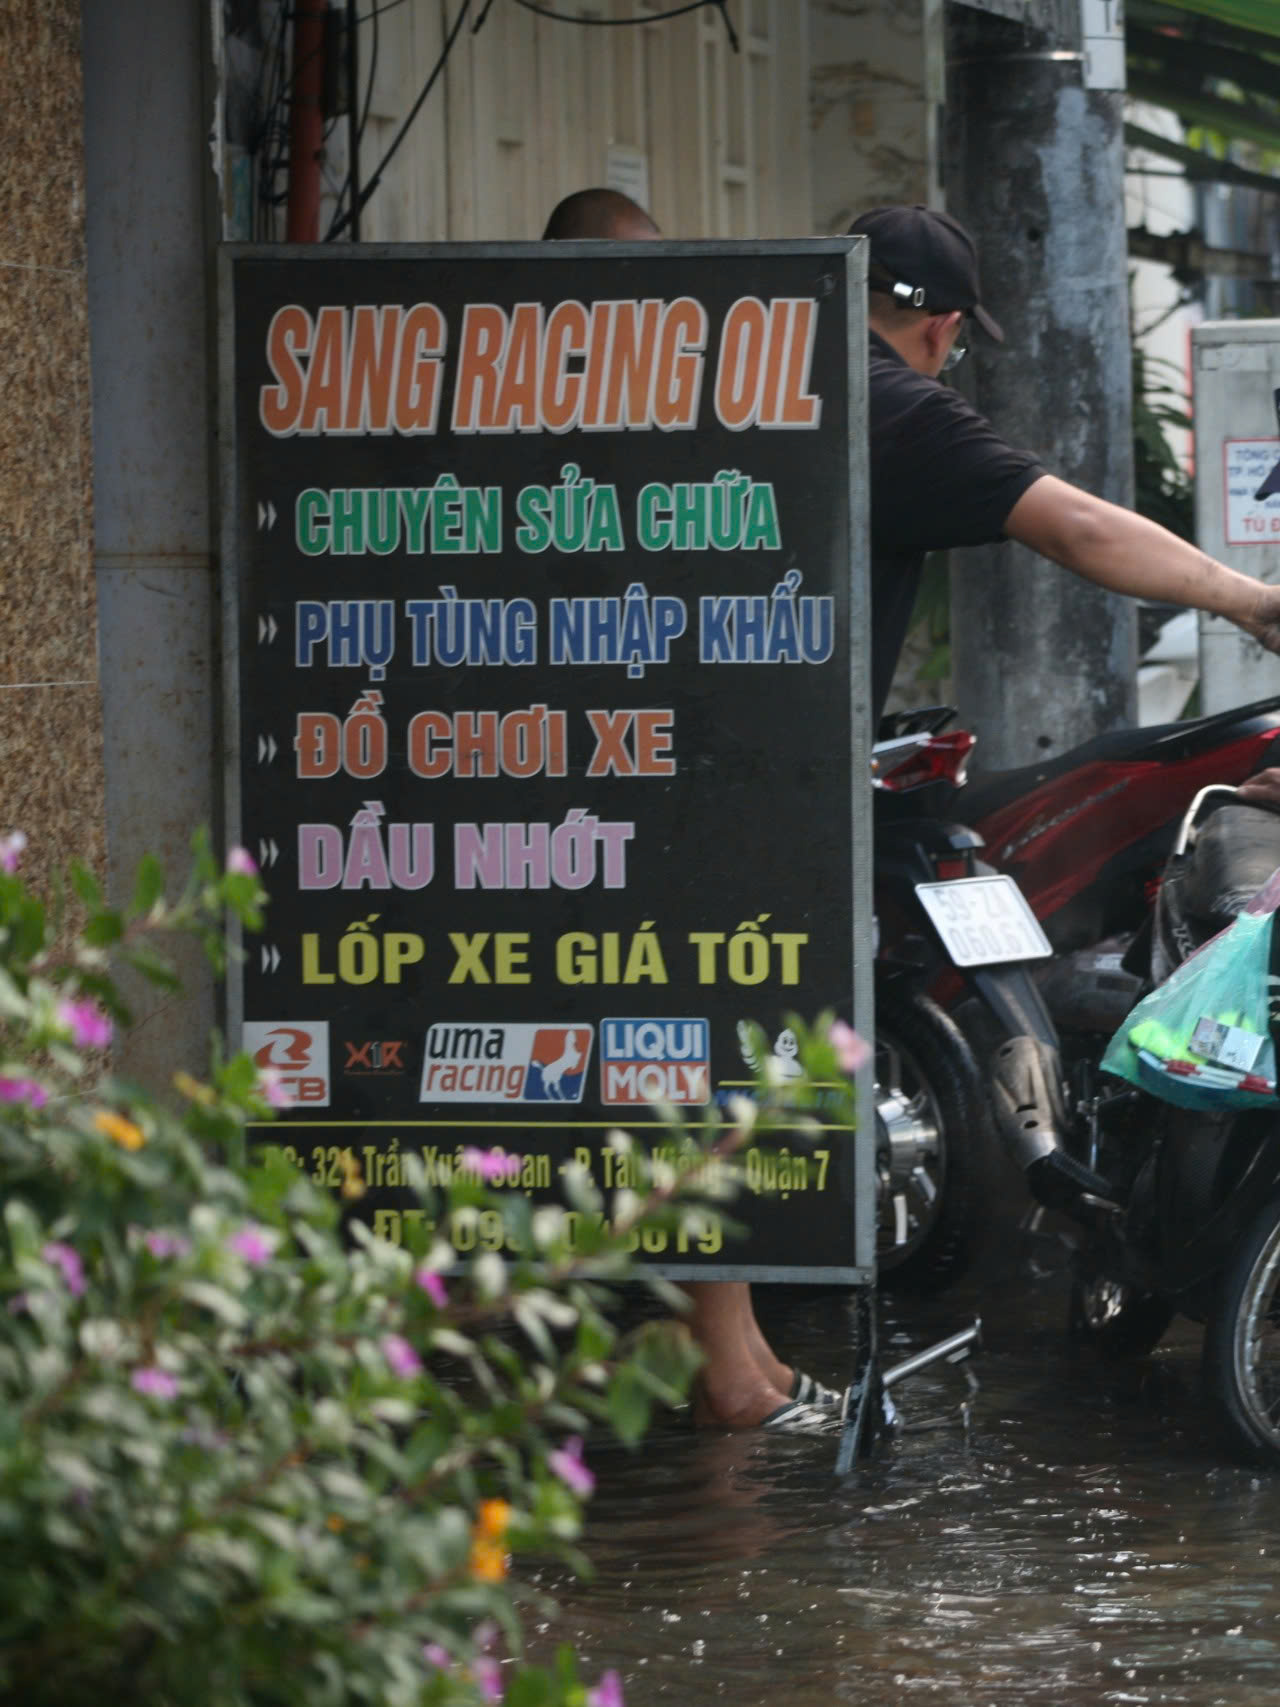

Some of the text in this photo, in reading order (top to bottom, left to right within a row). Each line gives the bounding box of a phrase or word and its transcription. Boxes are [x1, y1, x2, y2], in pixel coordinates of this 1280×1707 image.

[259, 297, 822, 438] SANG RACING OIL
[296, 463, 781, 556] CHUYÊN SỬA CHỮA
[295, 569, 834, 681] PHỤ TÙNG NHẬP KHẨU
[294, 690, 677, 780] ĐỒ CHƠI XE
[297, 801, 635, 891] DẦU NHỚT
[302, 914, 809, 986] LỐP XE GIÁ TỐT
[430, 1028, 505, 1060] uma
[606, 1023, 703, 1061] LIQUI
[426, 1064, 525, 1099] racing
[606, 1065, 707, 1100] MOLY
[746, 1148, 808, 1200] Quận
[813, 1150, 831, 1191] 7
